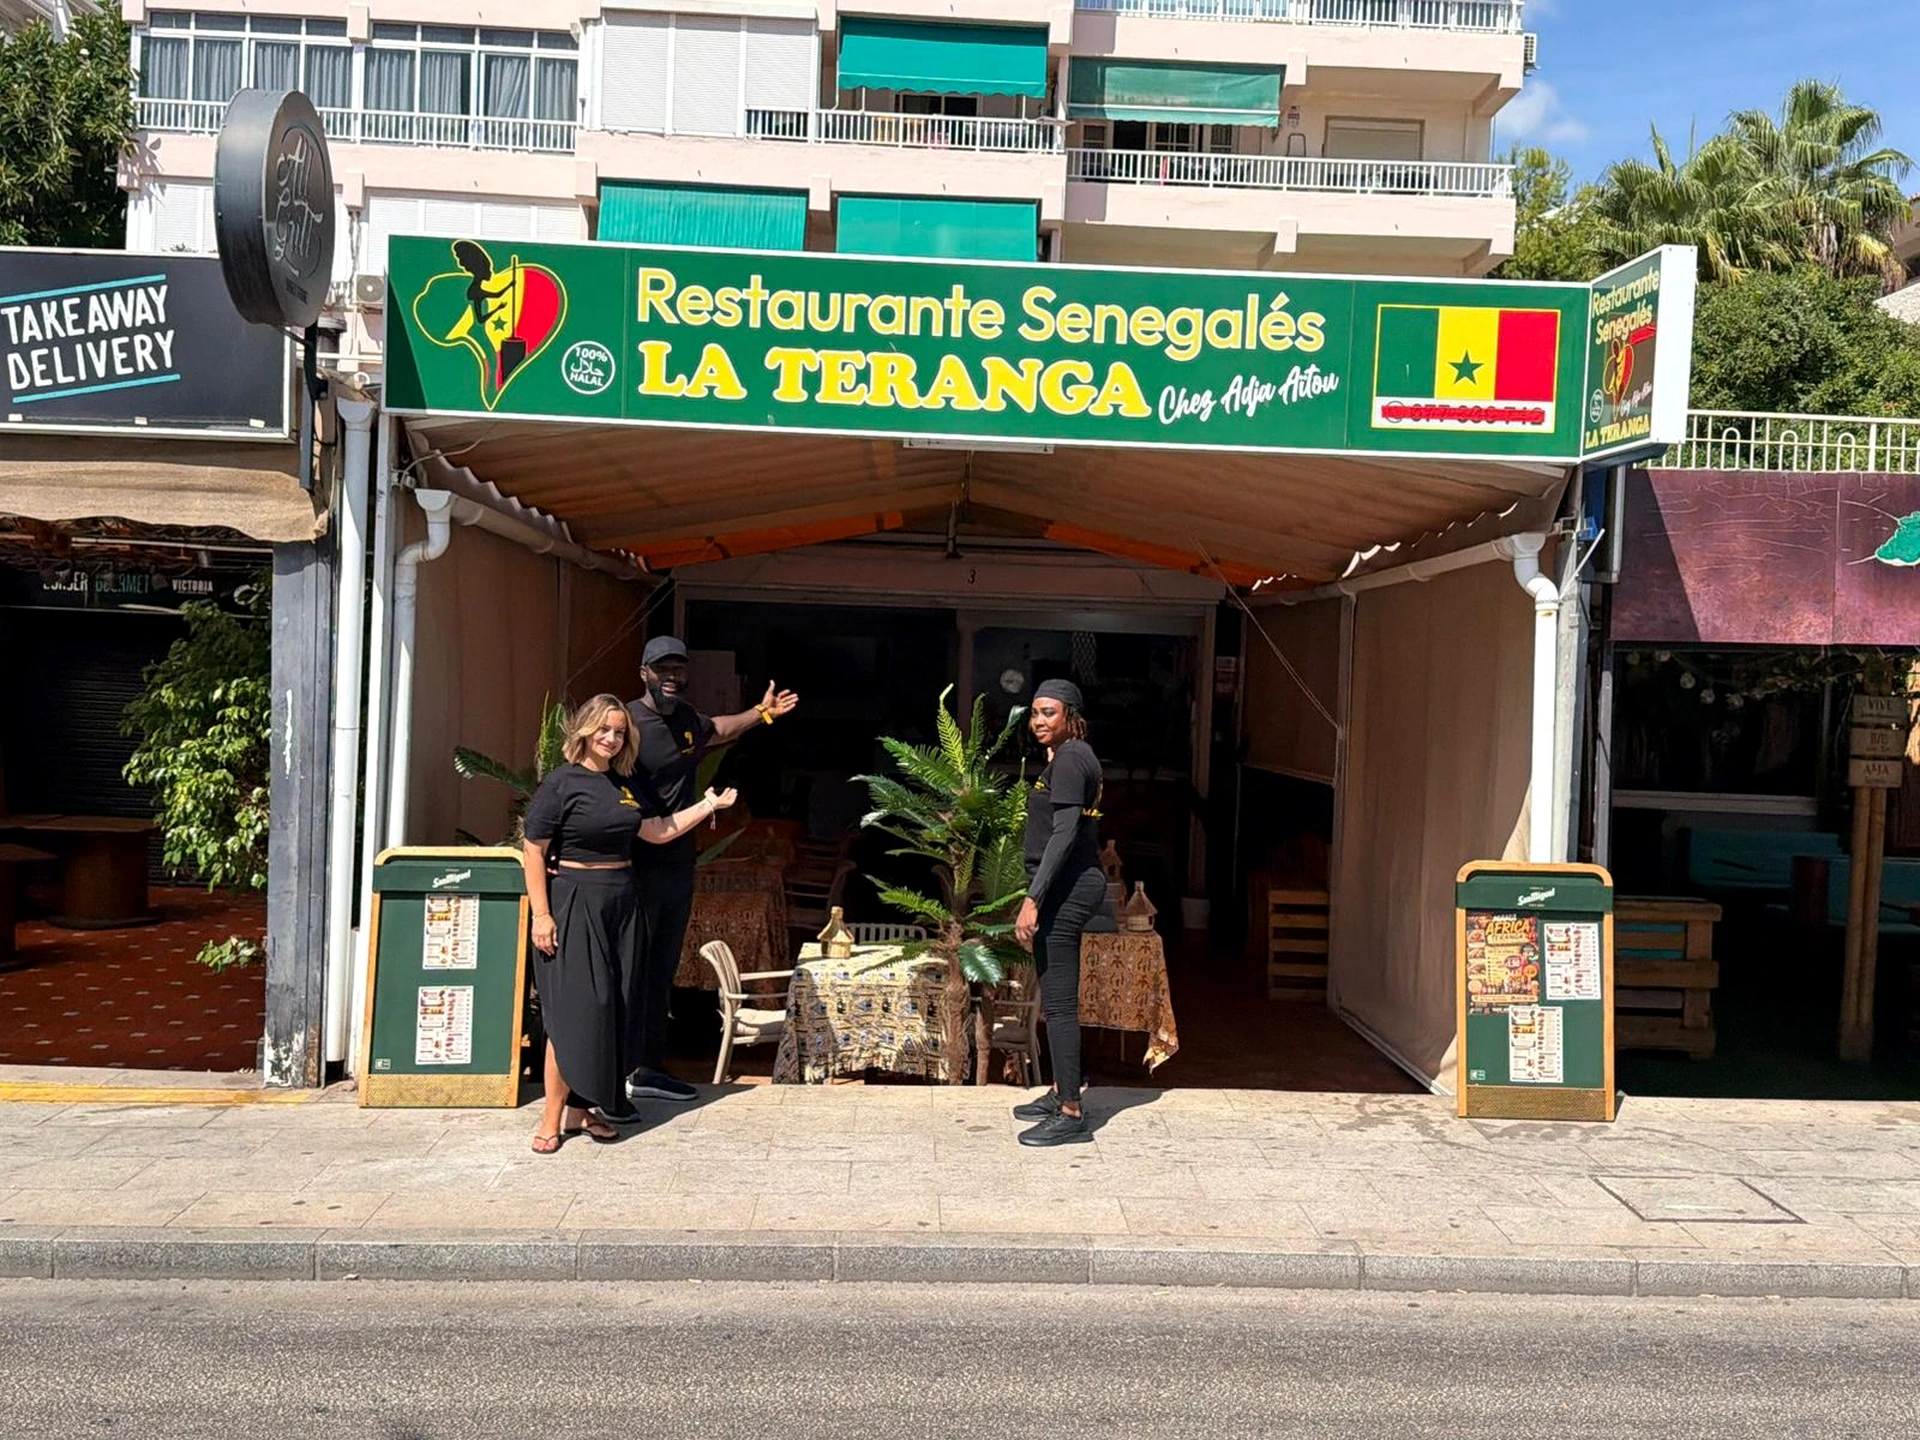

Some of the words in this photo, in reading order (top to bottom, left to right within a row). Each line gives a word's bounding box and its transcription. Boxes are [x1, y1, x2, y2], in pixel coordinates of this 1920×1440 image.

[1592, 266, 1660, 318] Restaurante
[637, 267, 1005, 341] Restaurante
[1017, 285, 1327, 361] Senegalés
[1595, 298, 1653, 345] Senegalés
[7, 330, 174, 391] DELIVERY
[570, 357, 604, 377] حلال
[575, 347, 608, 363] 100%
[570, 372, 603, 387] HALAL
[638, 340, 747, 400] LA
[764, 346, 1152, 418] TERANGA
[1158, 385, 1217, 425] Chez
[1220, 374, 1276, 418] Adja
[1585, 431, 1600, 449] LA
[1600, 413, 1650, 445] TERANGA
[172, 579, 214, 593] VICTORIA
[967, 569, 976, 584] 3
[1485, 920, 1530, 935] AFRICA
